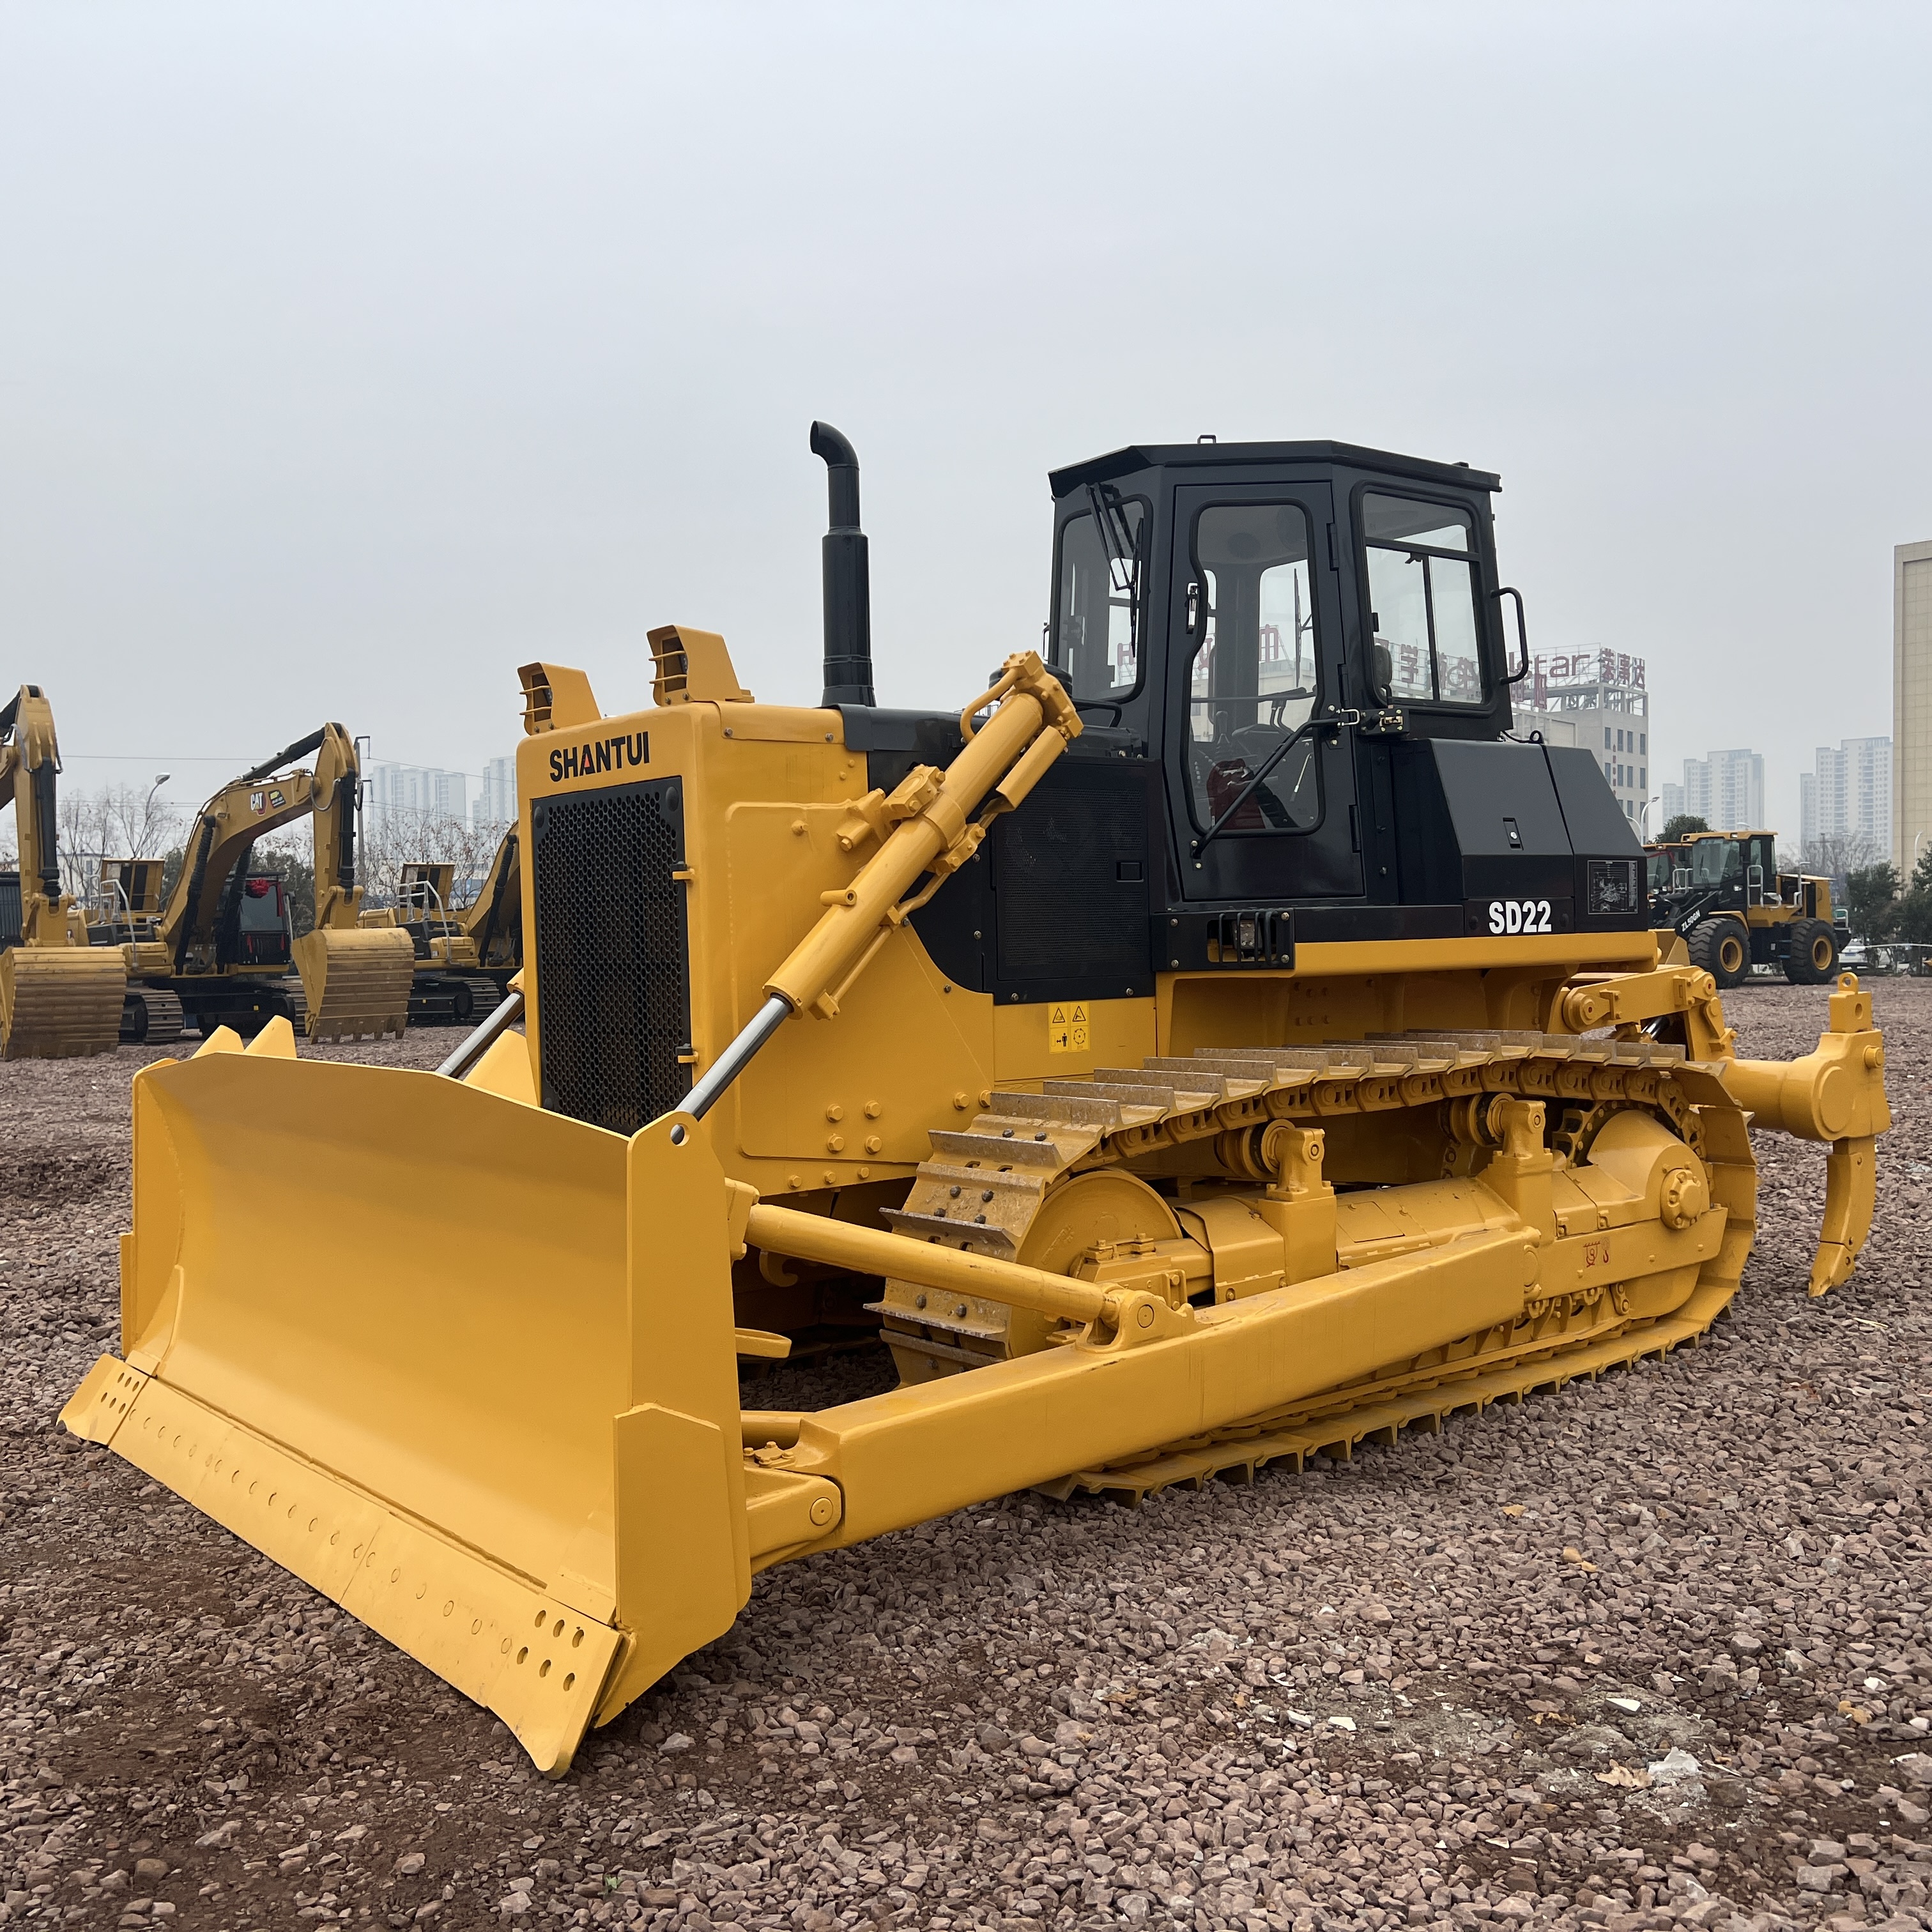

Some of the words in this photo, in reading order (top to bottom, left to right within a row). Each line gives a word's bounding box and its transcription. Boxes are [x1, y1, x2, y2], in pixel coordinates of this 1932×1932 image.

[549, 731, 650, 783] SHANTUI
[250, 792, 263, 811] CAT
[1489, 900, 1552, 934] SD22
